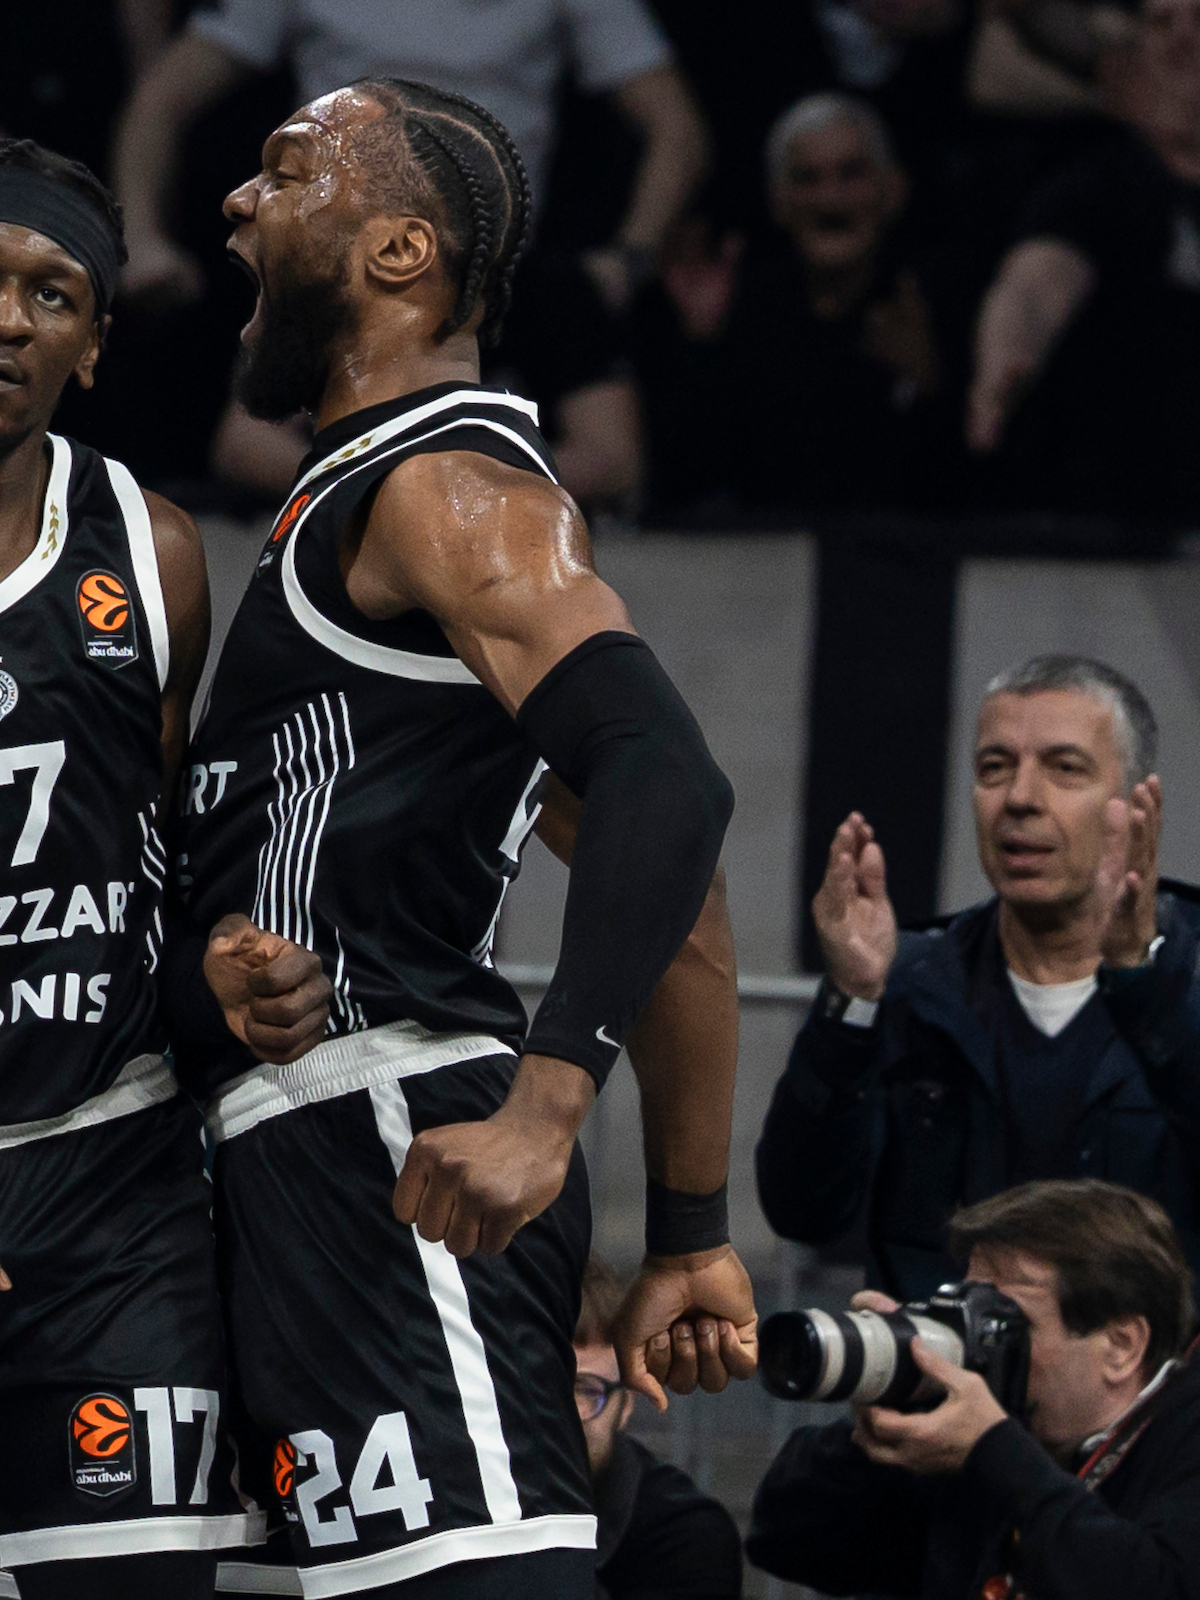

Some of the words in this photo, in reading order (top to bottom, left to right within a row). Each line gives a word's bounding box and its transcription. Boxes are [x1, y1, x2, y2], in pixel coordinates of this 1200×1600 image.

[10, 972, 112, 1024] NIS
[76, 1473, 97, 1485] abu
[97, 1470, 132, 1483] dhabi
[133, 1387, 220, 1505] 17
[288, 1410, 435, 1548] 24
